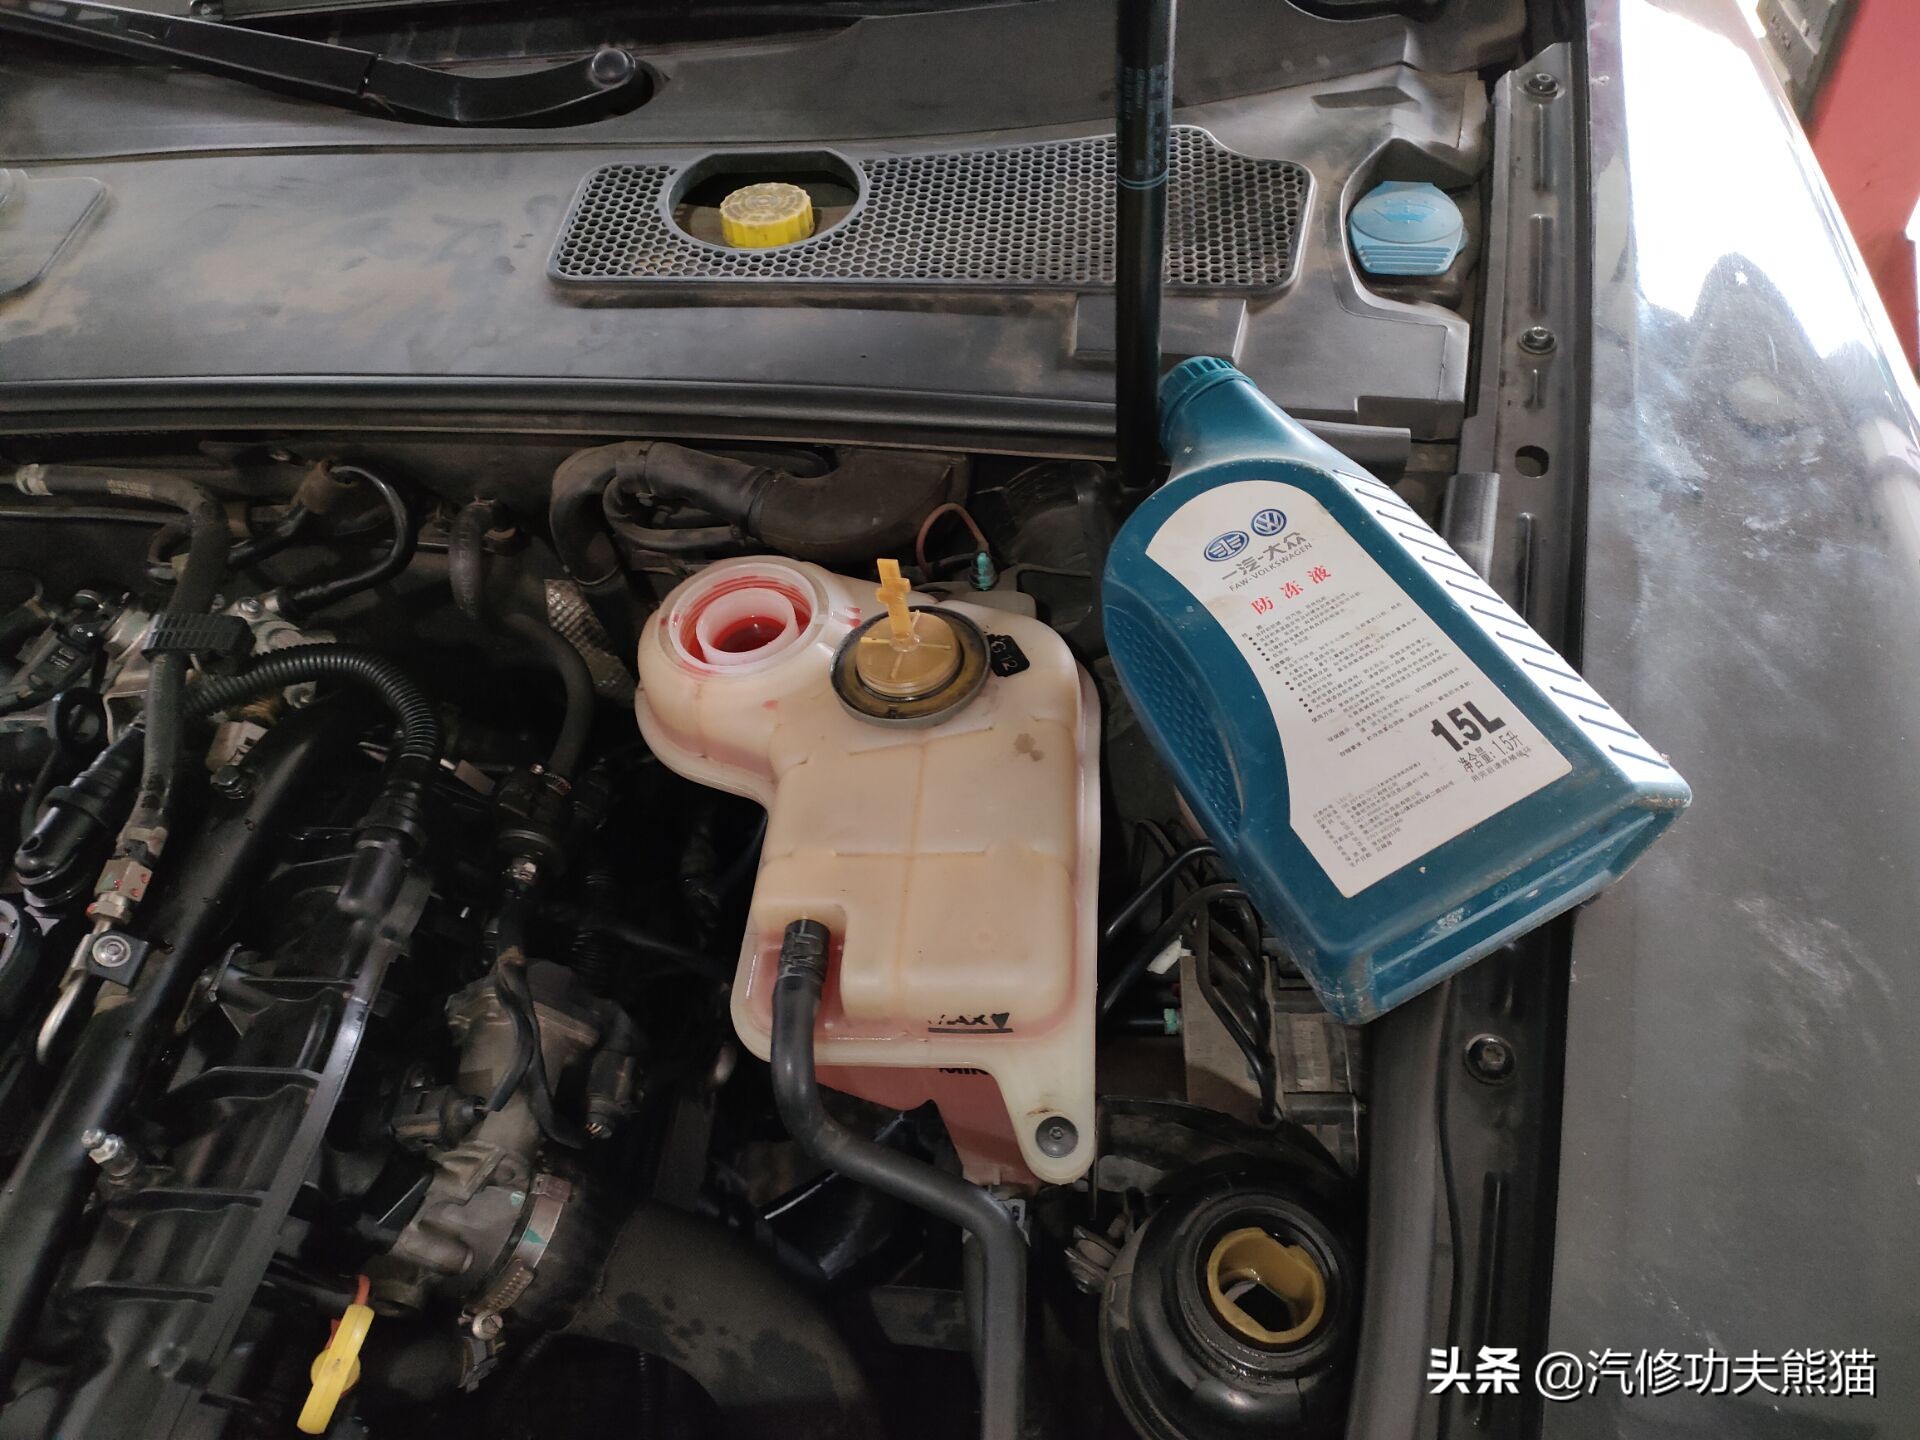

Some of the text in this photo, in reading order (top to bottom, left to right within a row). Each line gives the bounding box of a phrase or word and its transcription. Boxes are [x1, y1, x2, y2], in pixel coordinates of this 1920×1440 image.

[1221, 531, 1306, 580] 一汽-大众
[1228, 542, 1313, 592] FAW-VOLKSWAGEN
[1430, 700, 1506, 752] 1.5L
[928, 1014, 988, 1026] AX
